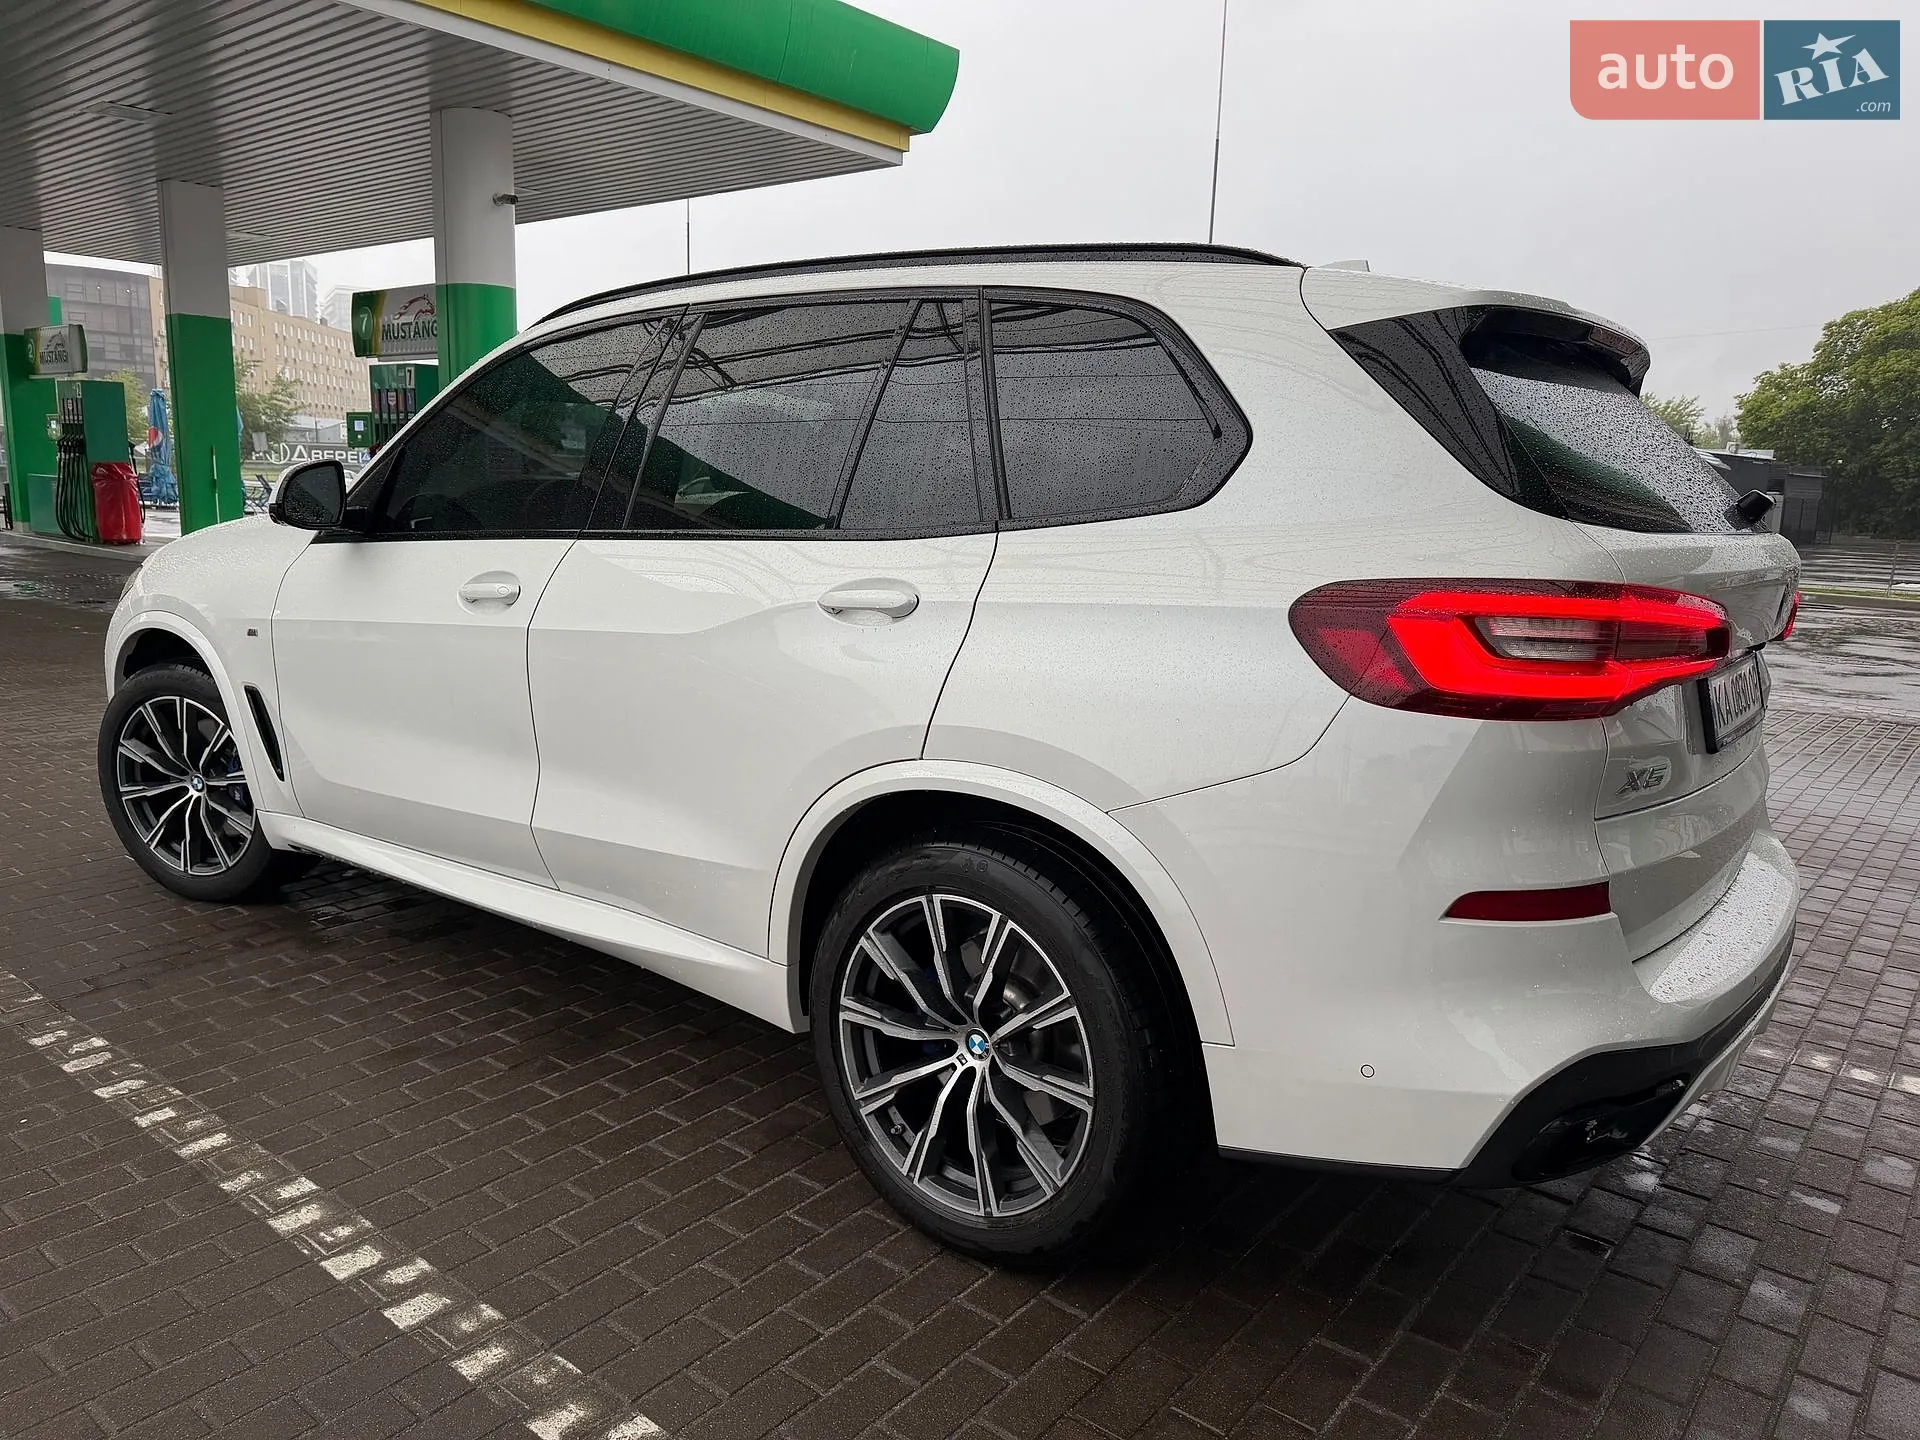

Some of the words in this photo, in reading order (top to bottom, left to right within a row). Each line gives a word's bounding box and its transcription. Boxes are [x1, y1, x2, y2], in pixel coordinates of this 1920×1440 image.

[360, 313, 368, 334] 7
[381, 320, 438, 341] MUSTANG
[406, 368, 413, 388] 7
[291, 445, 365, 463] ДВЕРЕ
